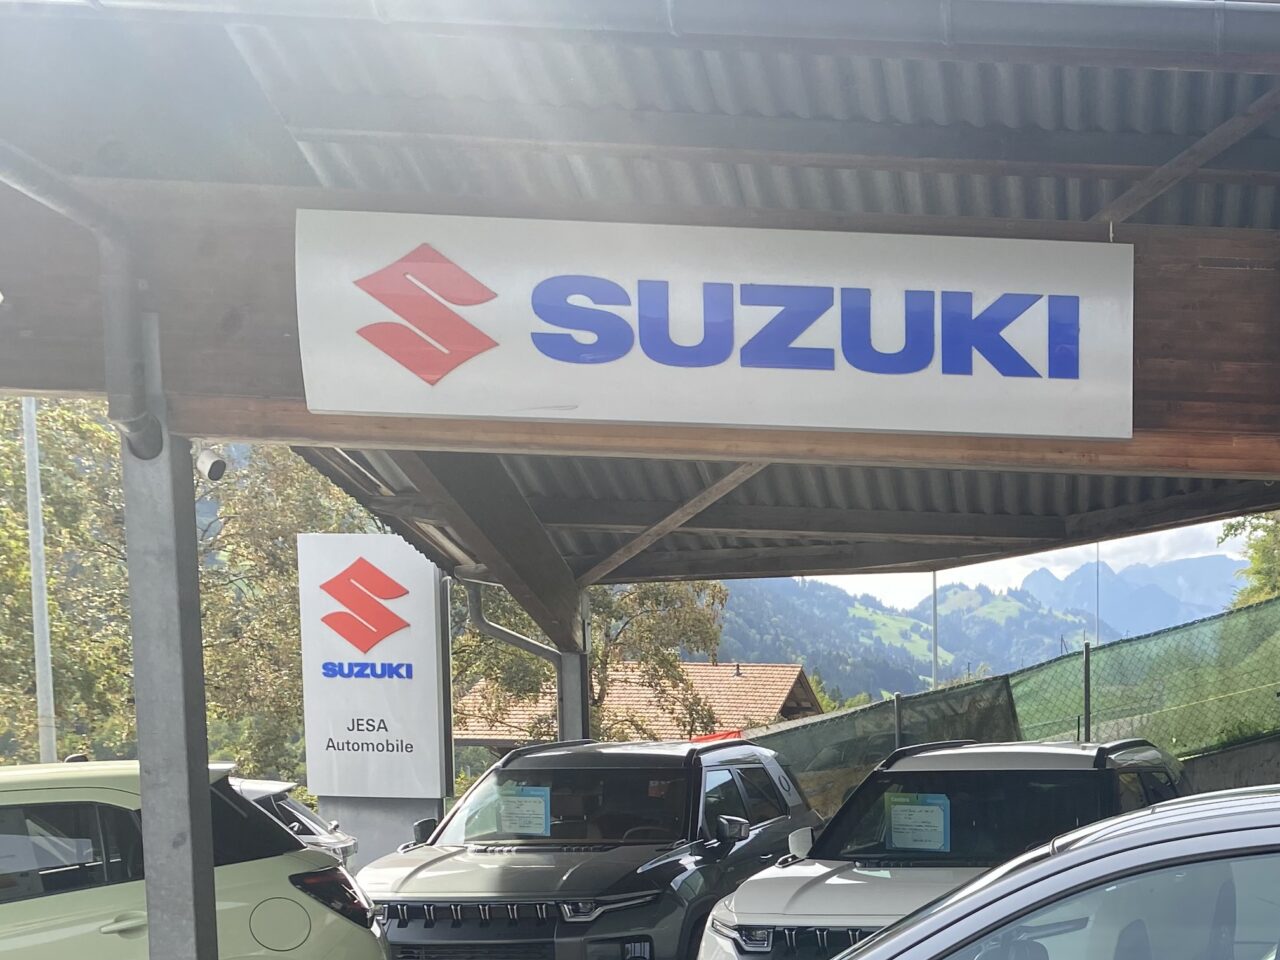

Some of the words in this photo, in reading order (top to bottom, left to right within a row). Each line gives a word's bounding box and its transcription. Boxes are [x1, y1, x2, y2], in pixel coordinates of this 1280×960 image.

[530, 274, 1081, 380] SUZUKI
[322, 662, 413, 680] SUZUKI
[346, 718, 389, 733] JESA
[325, 738, 414, 753] Automobile
